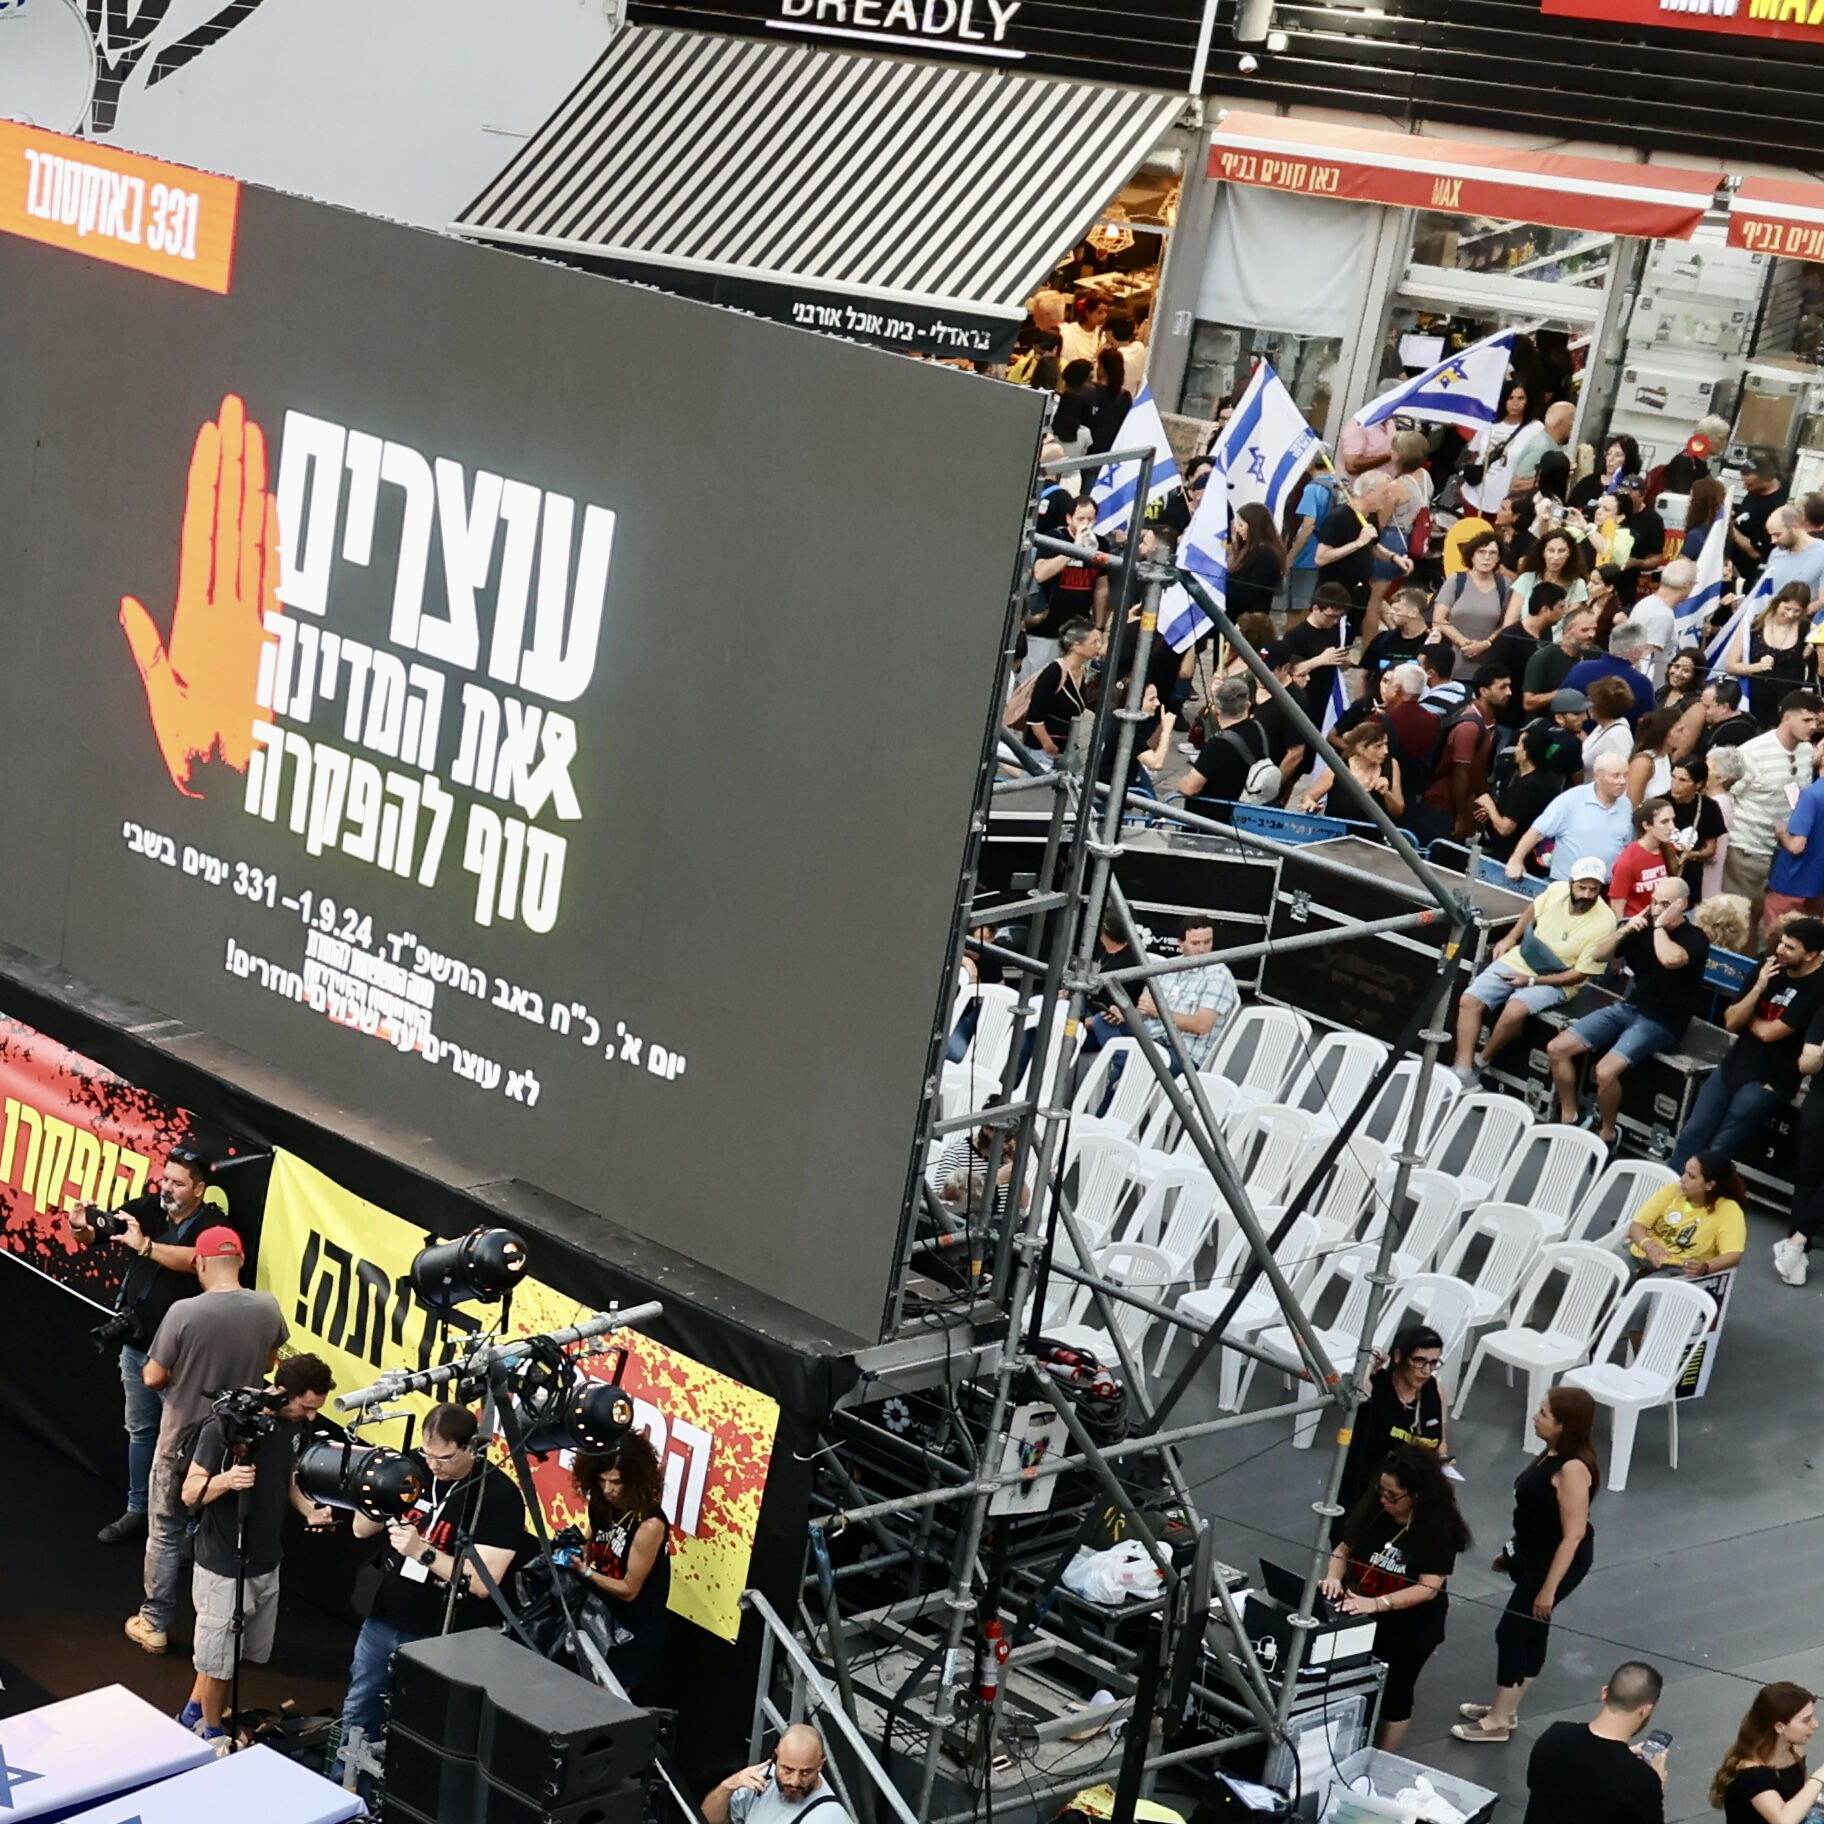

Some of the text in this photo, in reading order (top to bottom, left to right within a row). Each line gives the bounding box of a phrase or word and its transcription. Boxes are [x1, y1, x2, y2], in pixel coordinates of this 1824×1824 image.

[1220, 152, 1340, 192] כאן קונים בכיף
[1432, 178, 1463, 208] MAX
[24, 148, 200, 260] 331 באוקטובר
[1742, 221, 1784, 250] בכיף
[792, 302, 842, 327] אורבני
[846, 306, 882, 335] אוכל
[884, 318, 914, 341] בית
[930, 321, 990, 350] בראדלי
[274, 409, 617, 702] עוצרים
[256, 610, 542, 806] את המדינה
[121, 821, 176, 866] בשבי
[244, 718, 567, 933] סוף להפקרה
[181, 848, 228, 886] ימים
[233, 863, 277, 907] 331
[225, 938, 306, 1003] חוזרים!
[492, 980, 544, 1024] באב
[551, 1002, 600, 1046] כ"ח
[422, 1030, 501, 1090] עוצרים
[647, 1047, 686, 1081] יום
[506, 1068, 541, 1108] לא
